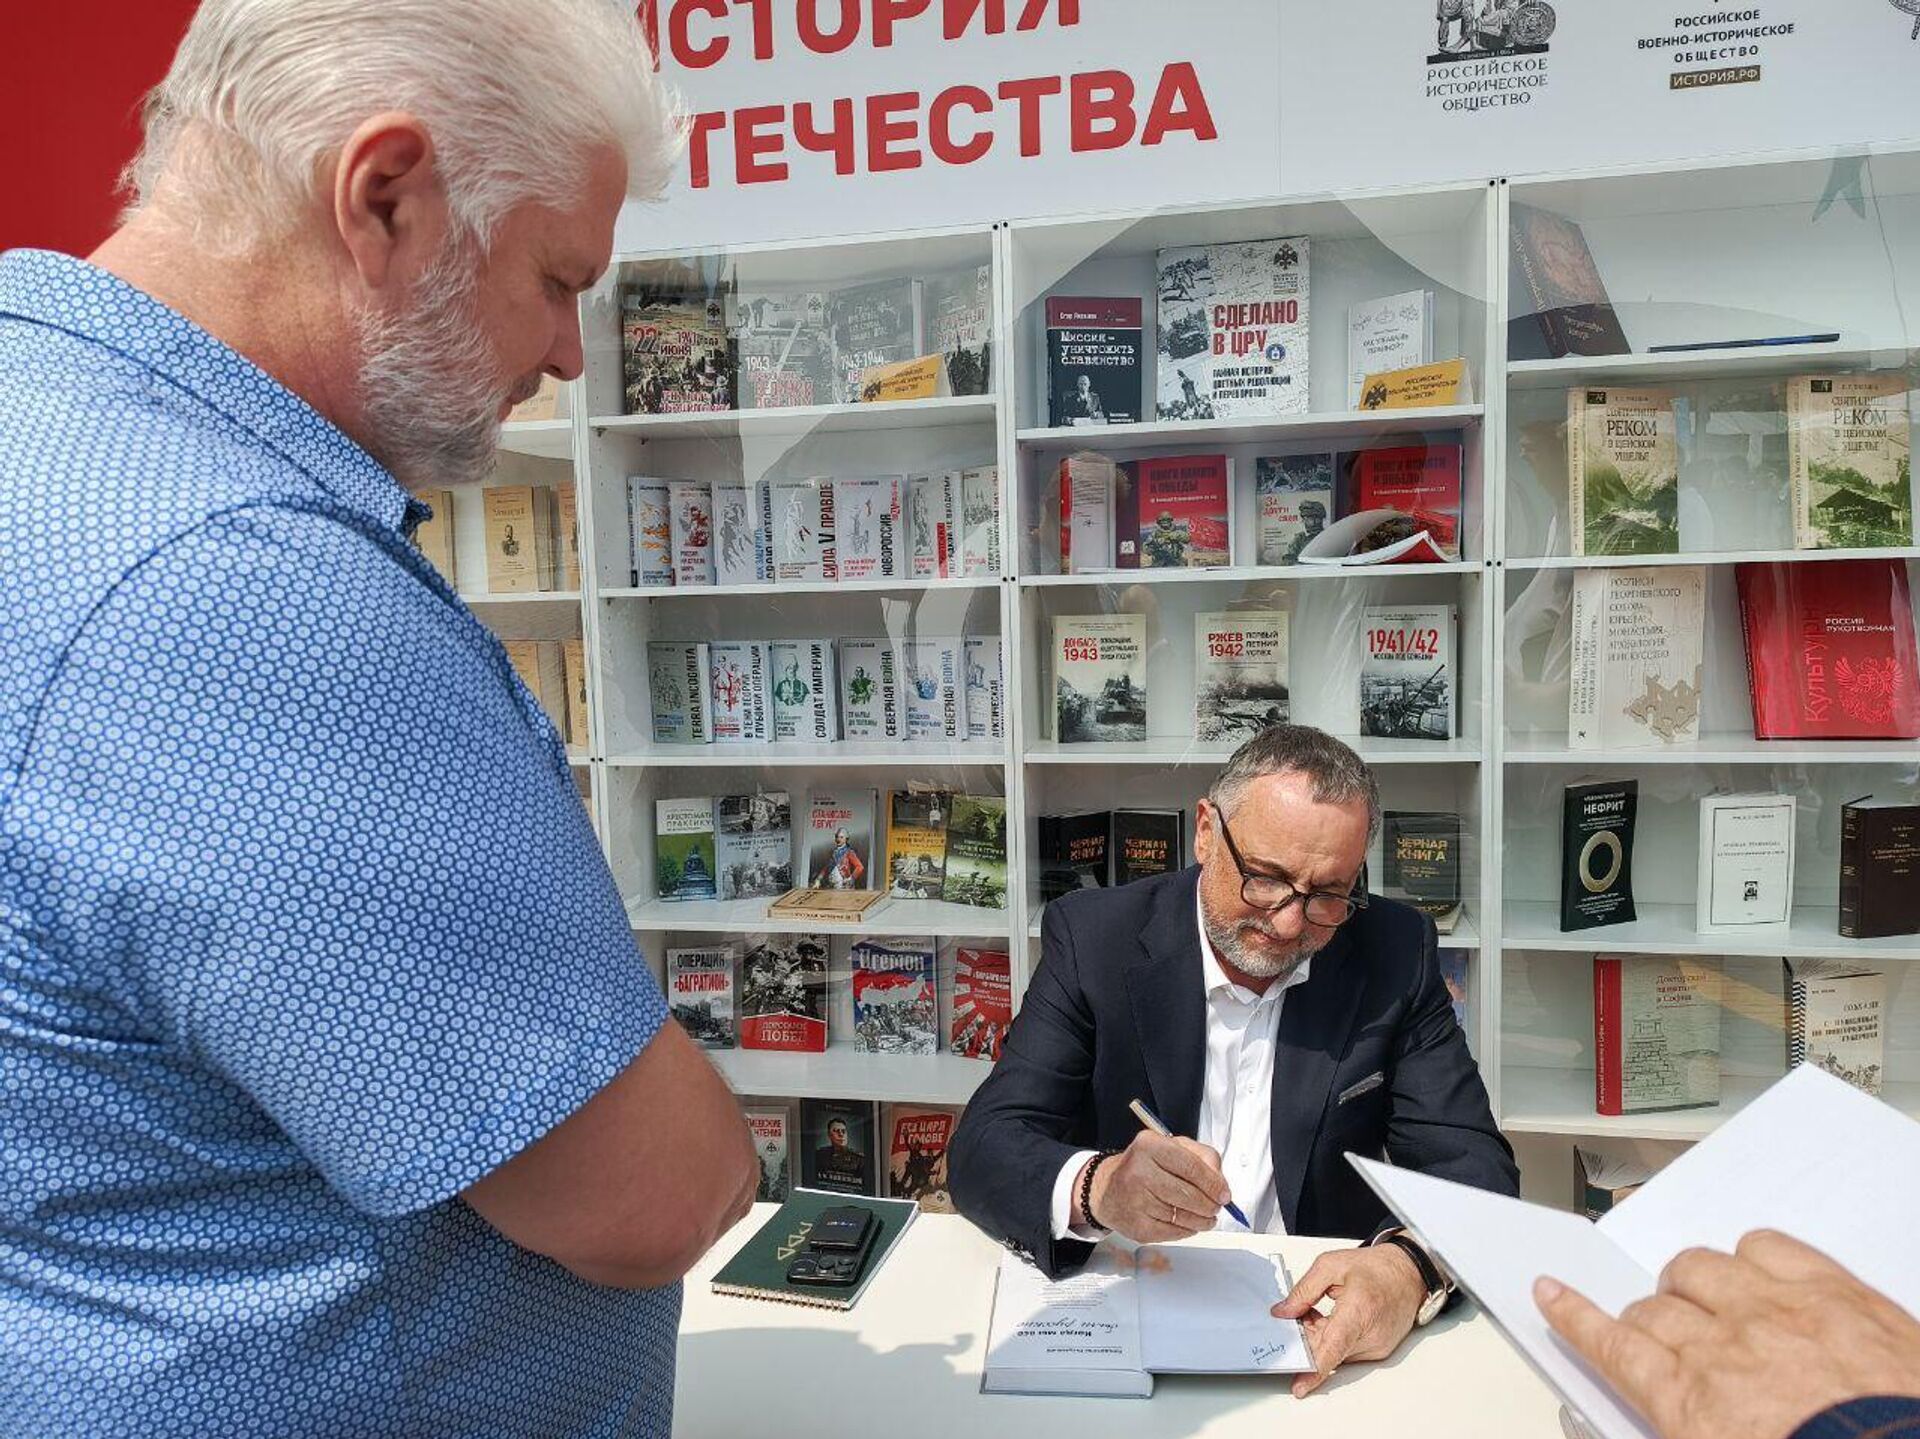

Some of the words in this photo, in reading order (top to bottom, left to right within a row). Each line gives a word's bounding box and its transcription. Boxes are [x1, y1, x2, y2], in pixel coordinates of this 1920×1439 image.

[1675, 9, 1760, 28] РОССИЙСКОЕ
[646, 0, 1080, 72] СТОРИ
[1637, 23, 1795, 49] ВОЕННО-ИСТОРИЧЕСКОЕ
[1674, 45, 1759, 63] ОБЩЕСТВО
[1427, 58, 1548, 81] РОССИЙСКОЕ
[1672, 67, 1759, 87] ИСТОРИЯ.РФ
[1426, 74, 1548, 97] ИСТОРИЧЕСКОЕ
[1442, 92, 1531, 111] ОБЩЕСТВО
[678, 61, 1218, 188] ТЕЧЕСТВА
[1213, 300, 1298, 330] СДЕЛАНО
[1213, 333, 1225, 355] В
[1231, 330, 1268, 357] ЦРУ
[745, 356, 770, 371] 1943
[1606, 420, 1658, 436] РЕКОМ
[1833, 410, 1888, 425] РЕКОМ
[820, 482, 835, 528] ПРАВДЕ
[818, 533, 836, 544] V
[880, 514, 893, 576] НОВОРОССИЯ
[823, 548, 836, 579] СИЛА
[1208, 633, 1244, 643] РЖЕВ
[1208, 643, 1244, 657] 1942
[1367, 628, 1438, 653] 1941/42
[1064, 648, 1098, 661] 1943
[686, 648, 700, 702] INCOGNITA
[811, 644, 823, 694] ИМПЕРИИ
[880, 651, 893, 684] ВОЙНА
[940, 650, 953, 684] ВОЙНА
[691, 706, 703, 739] TERRA
[813, 697, 826, 738] СОЛДАТ
[884, 686, 897, 737] СЕВЕРНАЯ
[944, 686, 956, 737] СЕВЕРНАЯ
[1584, 800, 1625, 815] НЕФРИТ
[666, 820, 710, 828] ПРАКТИКУ
[1397, 849, 1446, 861] КНИГА
[677, 953, 725, 968] ОПЕРАЦИЯ
